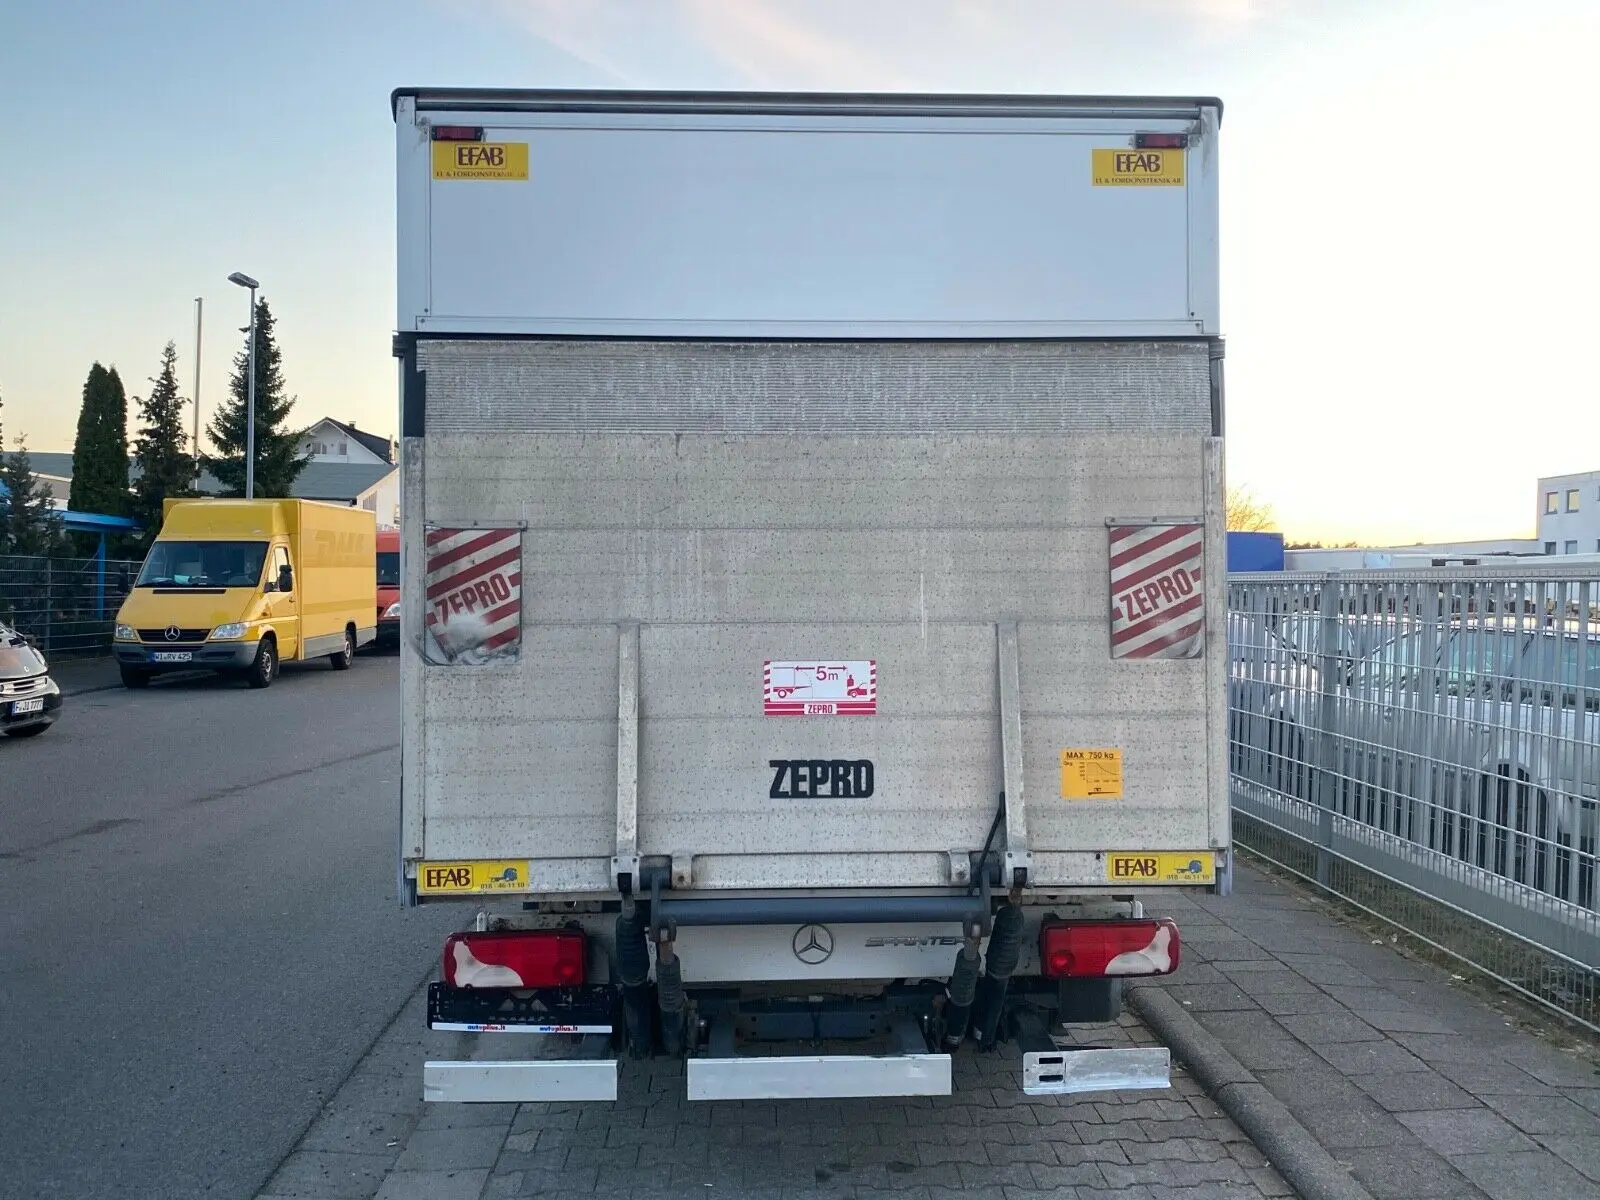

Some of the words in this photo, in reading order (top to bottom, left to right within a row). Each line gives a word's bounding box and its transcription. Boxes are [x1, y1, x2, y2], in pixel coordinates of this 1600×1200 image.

[457, 147, 504, 166] EFAB
[1115, 154, 1161, 172] EFAB
[1119, 568, 1194, 622] ZEPRO
[807, 704, 833, 714] ZEPRO
[1066, 751, 1084, 759] MAX
[1088, 751, 1103, 759] 750
[1104, 751, 1114, 760] kg
[769, 759, 875, 799] ZEPRO
[1114, 858, 1157, 877] EFAB
[426, 868, 471, 888] EFAB
